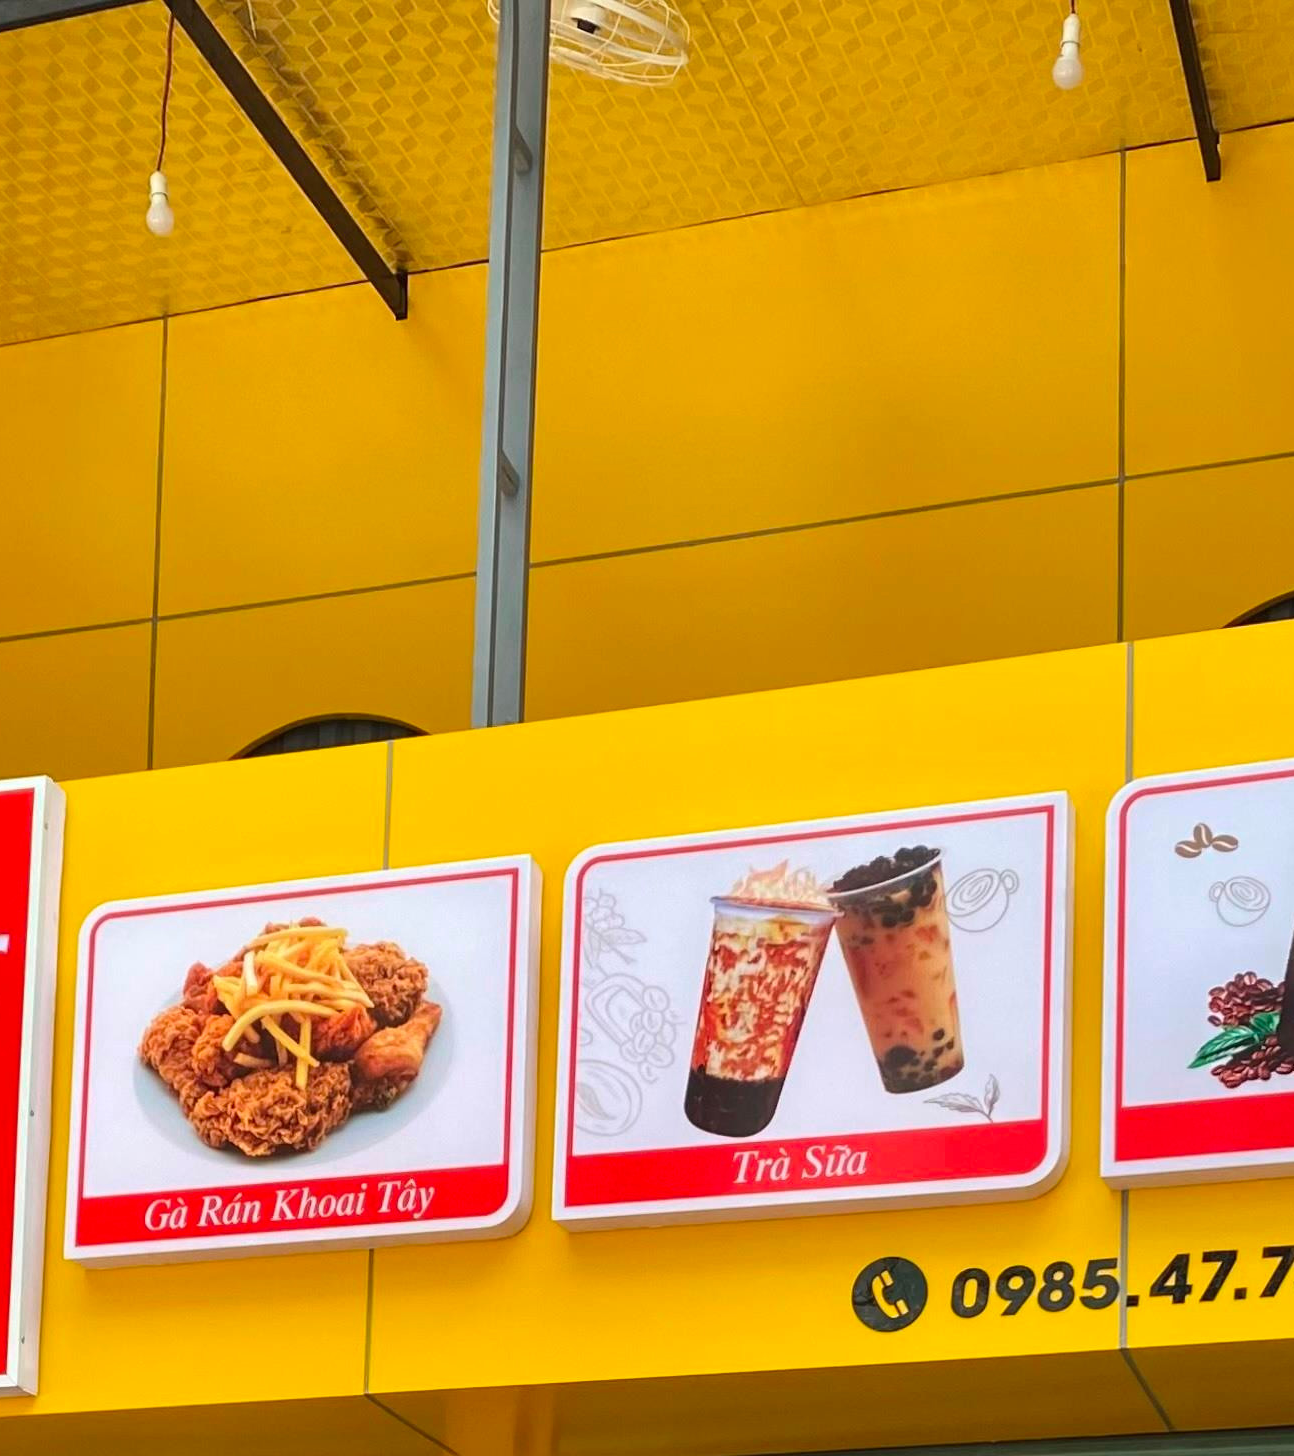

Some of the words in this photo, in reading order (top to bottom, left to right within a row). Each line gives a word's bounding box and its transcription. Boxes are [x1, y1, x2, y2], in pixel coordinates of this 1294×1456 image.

[732, 1147, 791, 1184] Trà
[801, 1144, 868, 1179] Sữa
[144, 1198, 188, 1231] Gà
[197, 1193, 261, 1227] Rán
[271, 1183, 367, 1221] Khoai
[378, 1178, 435, 1219] Tây
